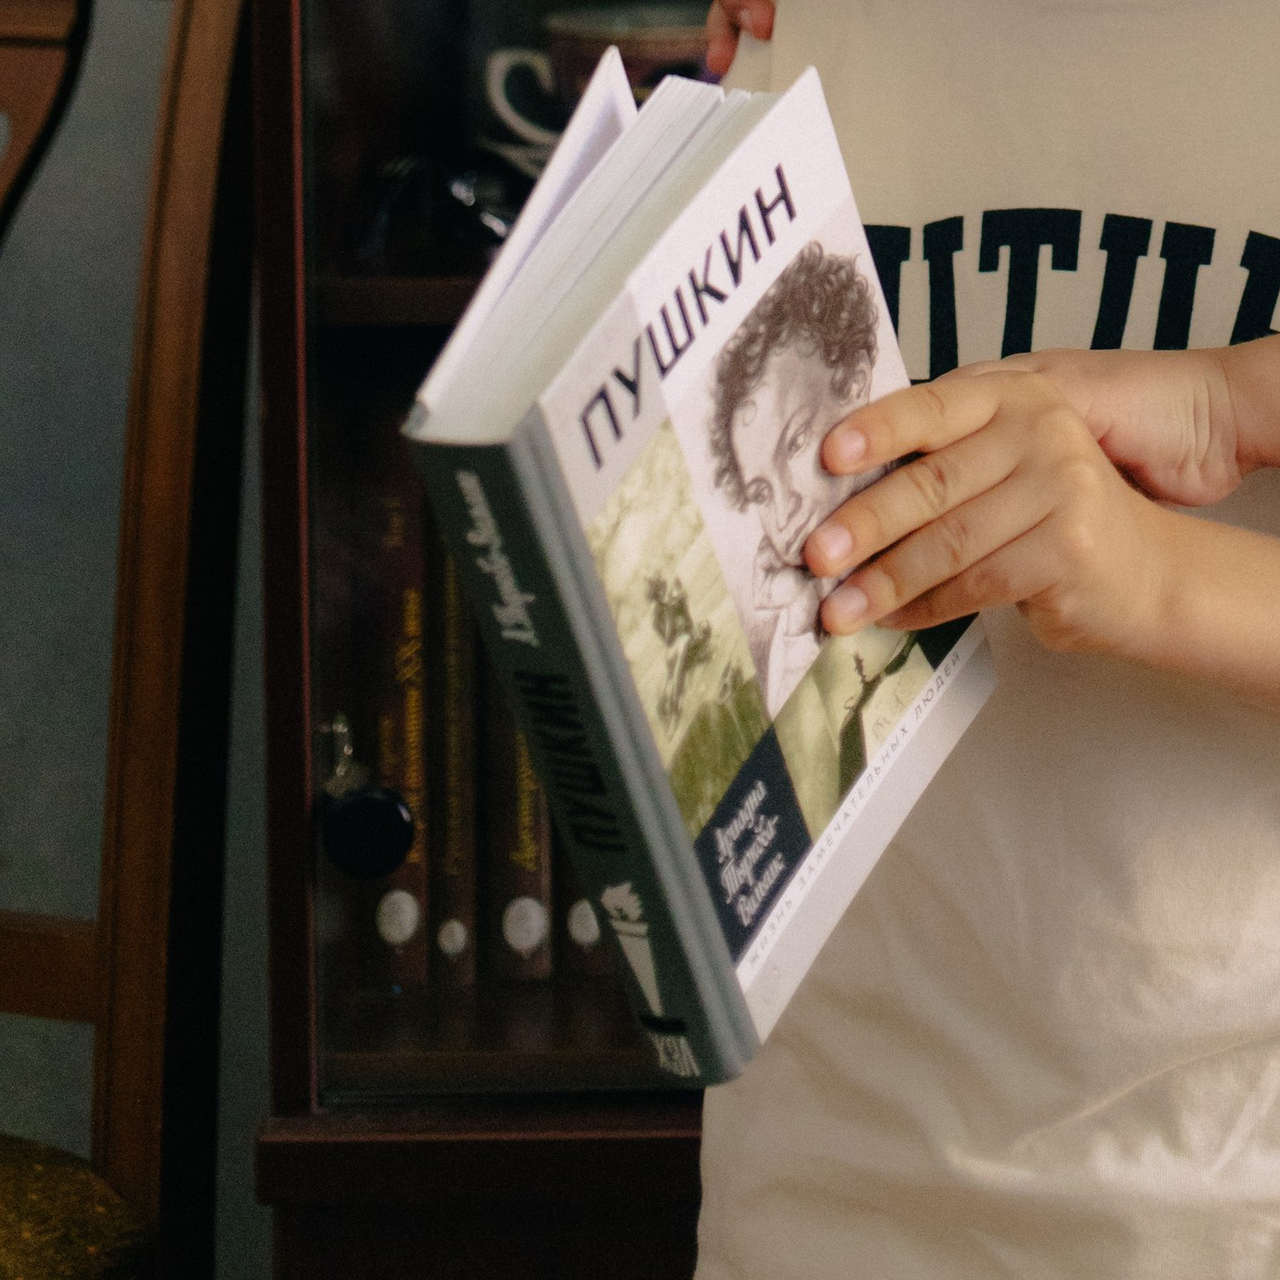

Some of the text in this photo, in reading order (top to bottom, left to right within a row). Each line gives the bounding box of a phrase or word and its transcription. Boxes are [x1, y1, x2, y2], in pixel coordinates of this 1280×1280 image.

[579, 162, 797, 470] ПУШКИН
[513, 670, 629, 854] ПУШКИН
[797, 725, 910, 890] ЗАМЕЧАТЕЛЬНЫХ
[914, 650, 961, 722] ЛЮДЕЙ
